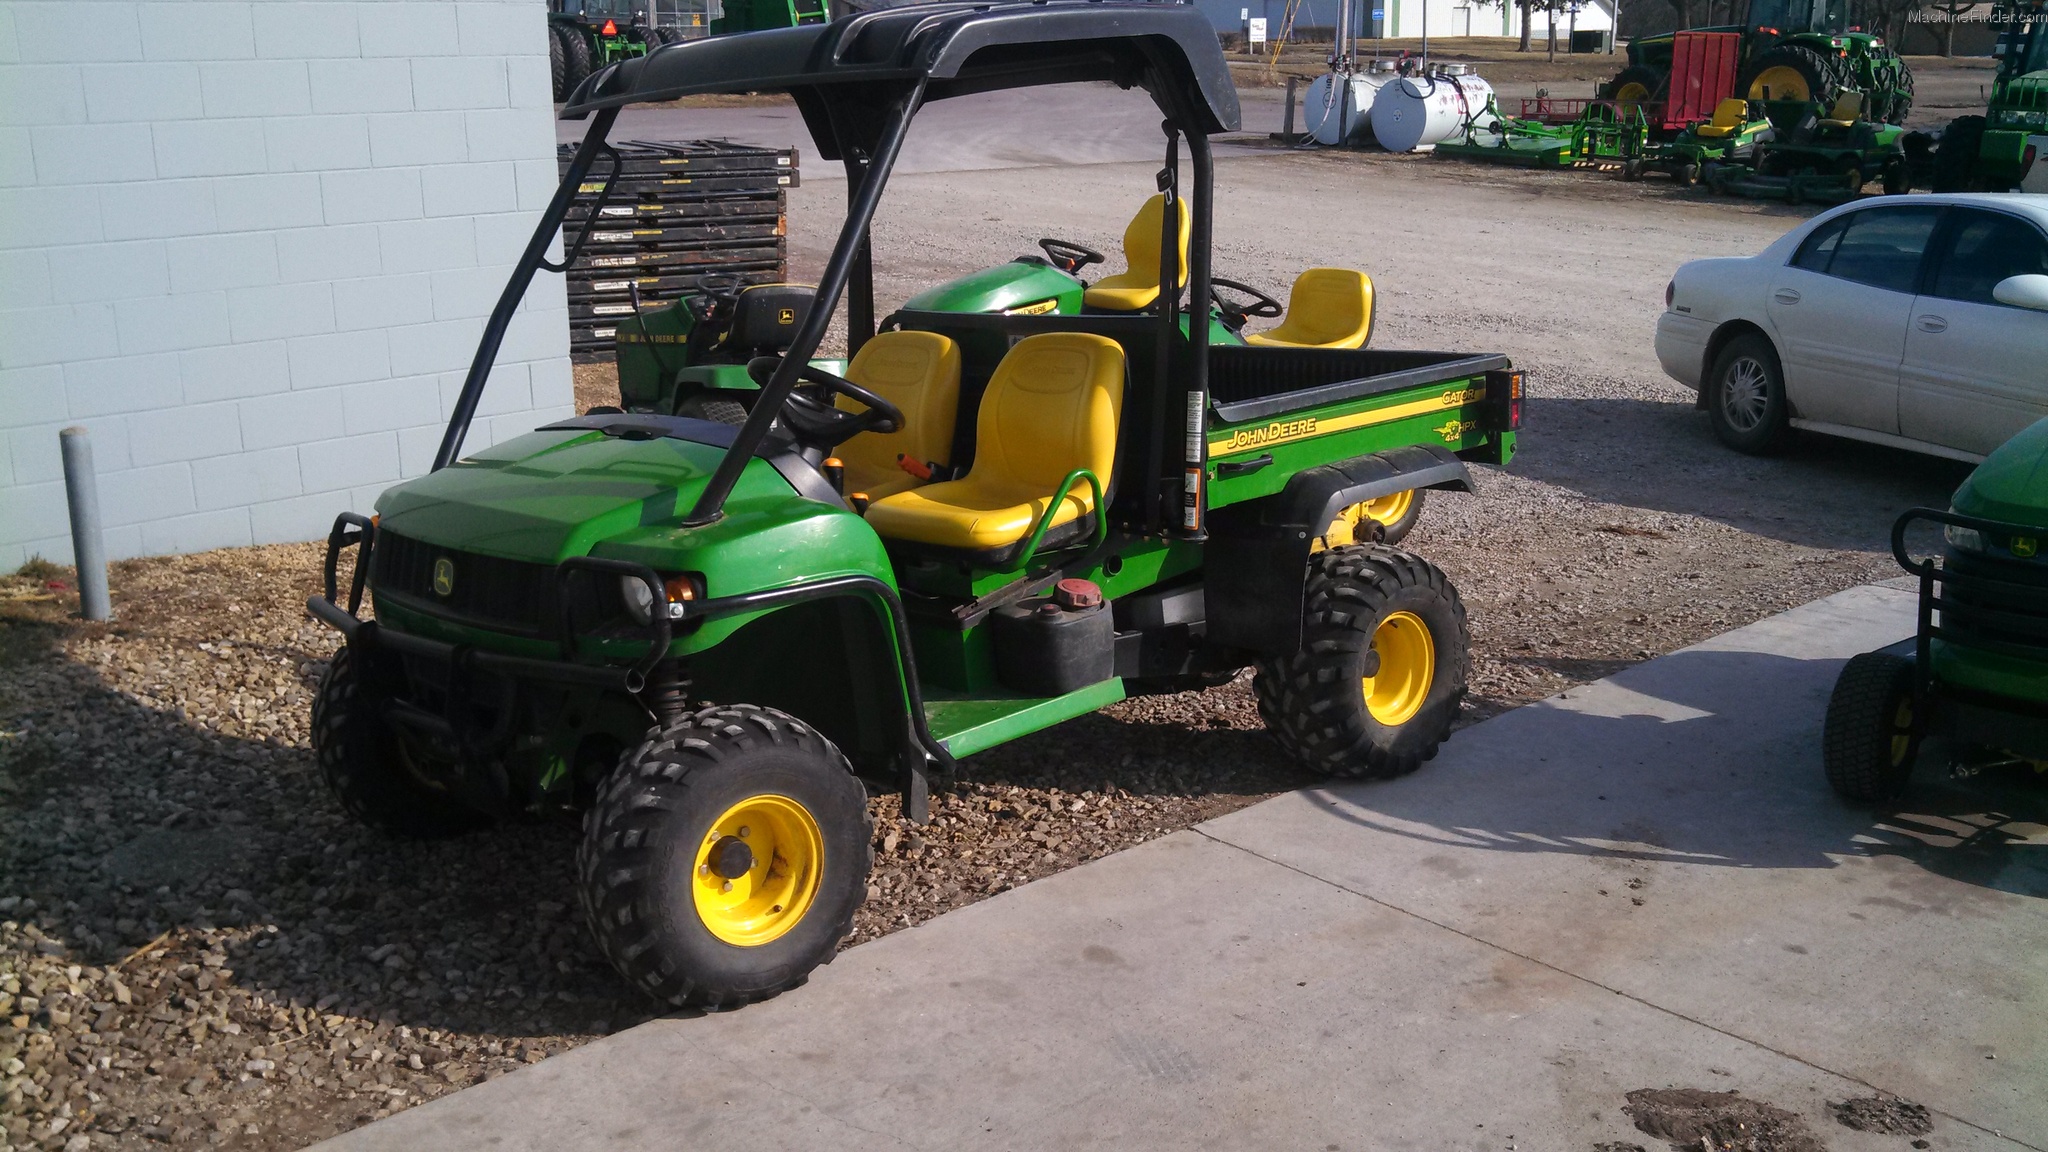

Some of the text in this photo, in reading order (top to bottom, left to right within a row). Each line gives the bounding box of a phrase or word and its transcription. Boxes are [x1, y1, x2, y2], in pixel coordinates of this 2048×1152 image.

[655, 334, 675, 343] DEERE
[1442, 389, 1475, 405] GATOR
[1227, 427, 1268, 449] JOHN
[1268, 417, 1317, 441] DEERE
[1457, 420, 1477, 433] HPX
[1444, 433, 1460, 442] 4x4
